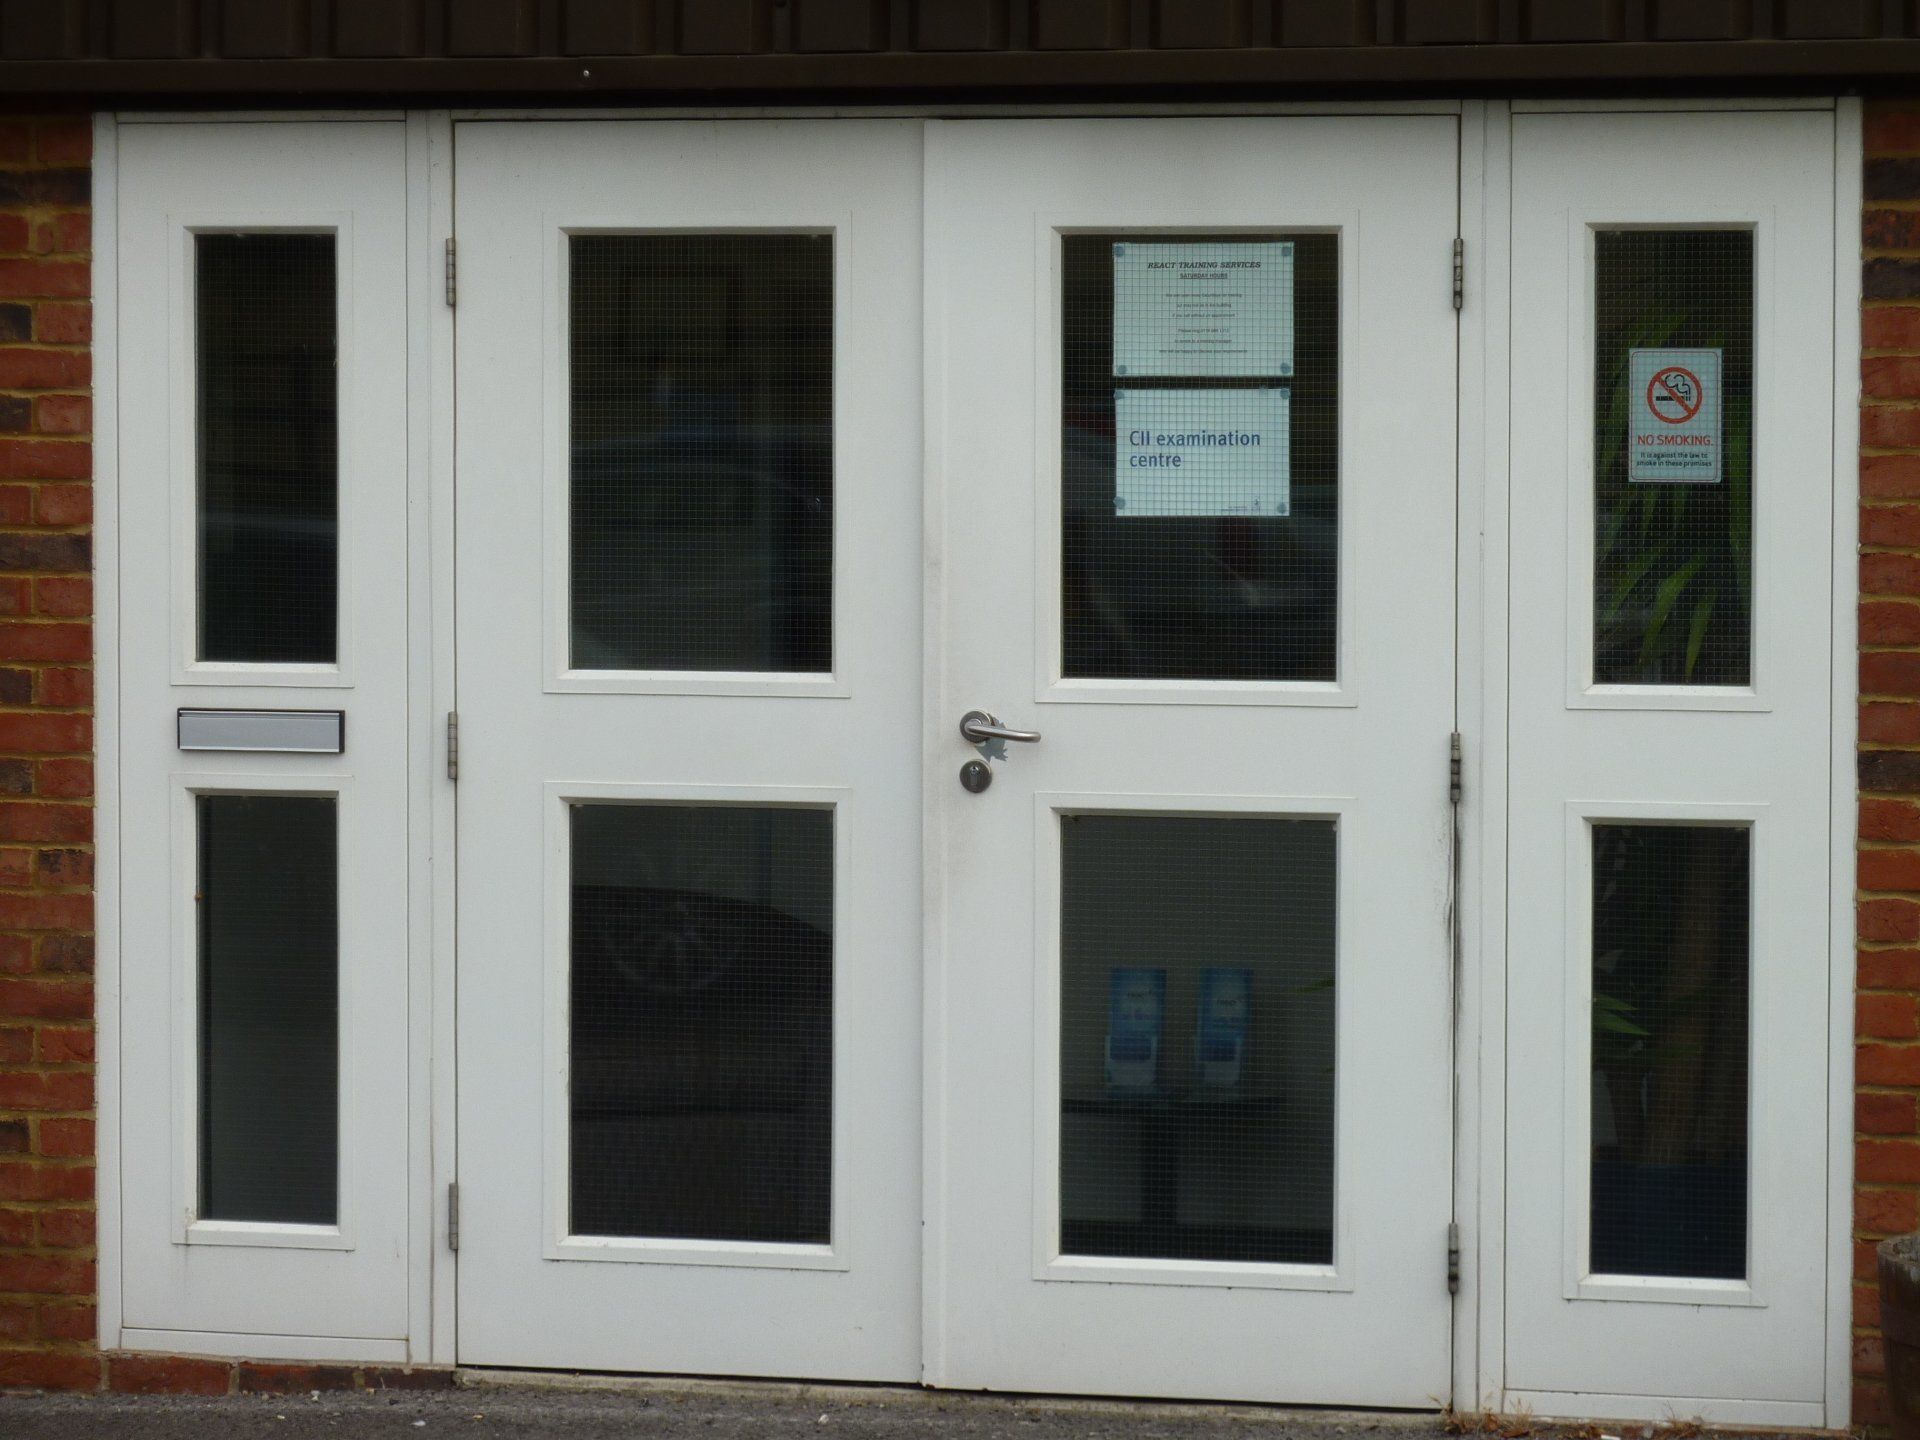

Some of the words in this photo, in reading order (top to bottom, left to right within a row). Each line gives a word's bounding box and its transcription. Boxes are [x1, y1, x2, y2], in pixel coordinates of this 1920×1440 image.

[1148, 261, 1176, 269] REACT
[1179, 261, 1218, 269] TRAINING
[1220, 261, 1261, 269] SERVICES
[1129, 430, 1150, 446] CII
[1156, 430, 1261, 446] examination
[1637, 434, 1654, 446] NO
[1129, 452, 1182, 467] centre
[1653, 452, 1676, 461] against
[1683, 460, 1712, 469] premises
